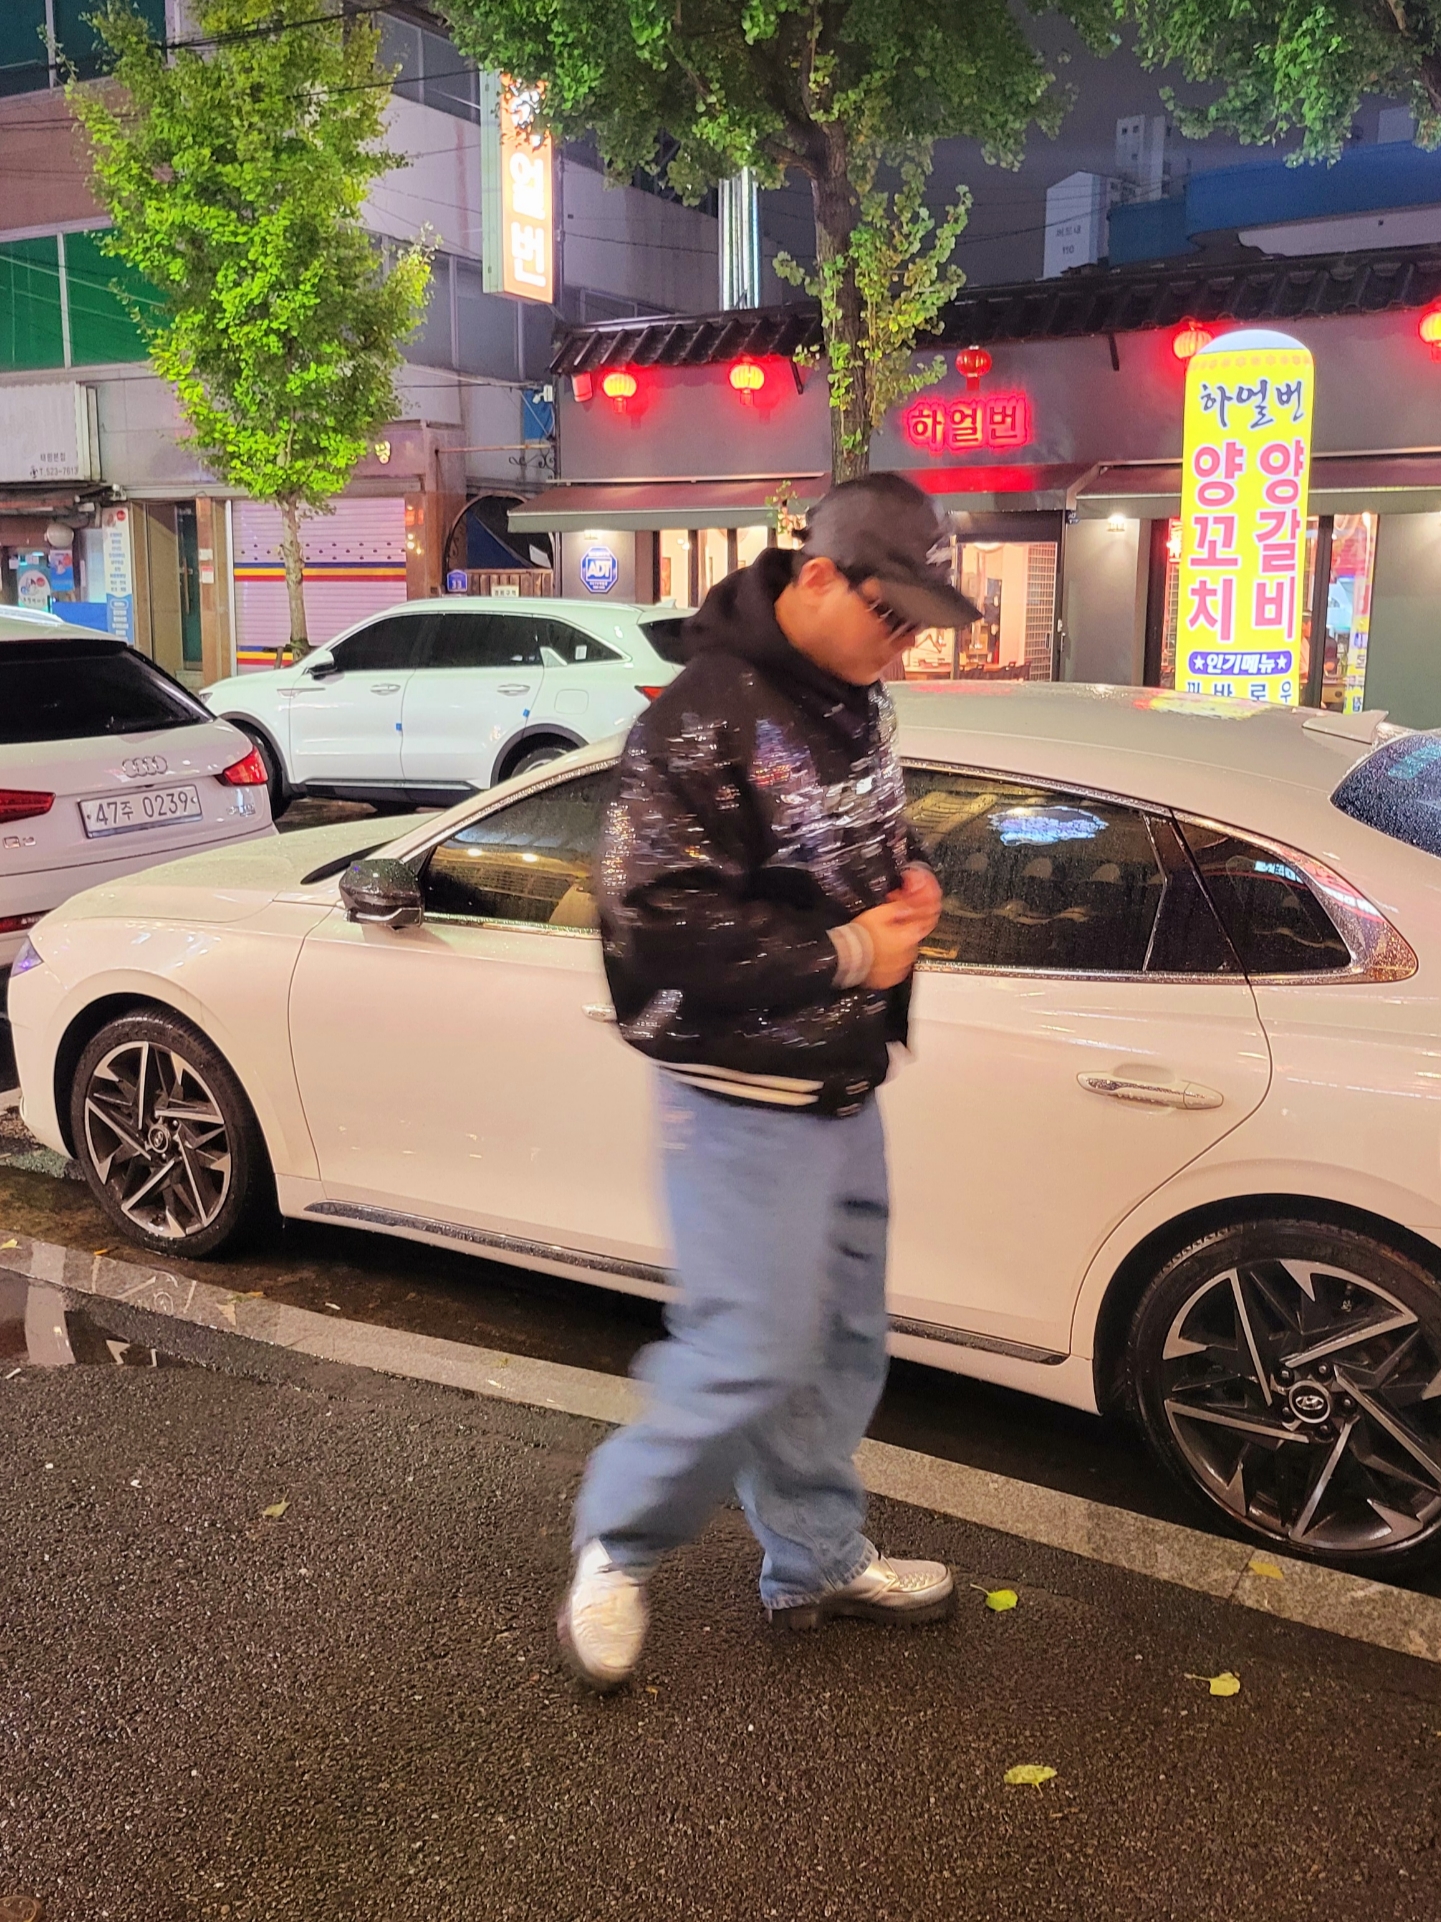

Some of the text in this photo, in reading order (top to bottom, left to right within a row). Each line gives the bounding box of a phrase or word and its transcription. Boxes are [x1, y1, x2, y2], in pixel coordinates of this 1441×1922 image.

[910, 404, 1020, 445] 하얼번
[1200, 379, 1304, 429] 하얼번
[1188, 441, 1245, 642] 양꼬치
[1254, 438, 1305, 640] 양갈비
[587, 559, 611, 578] ADT
[1206, 653, 1275, 674] 인기메뉴
[96, 791, 188, 825] 47주 0239
